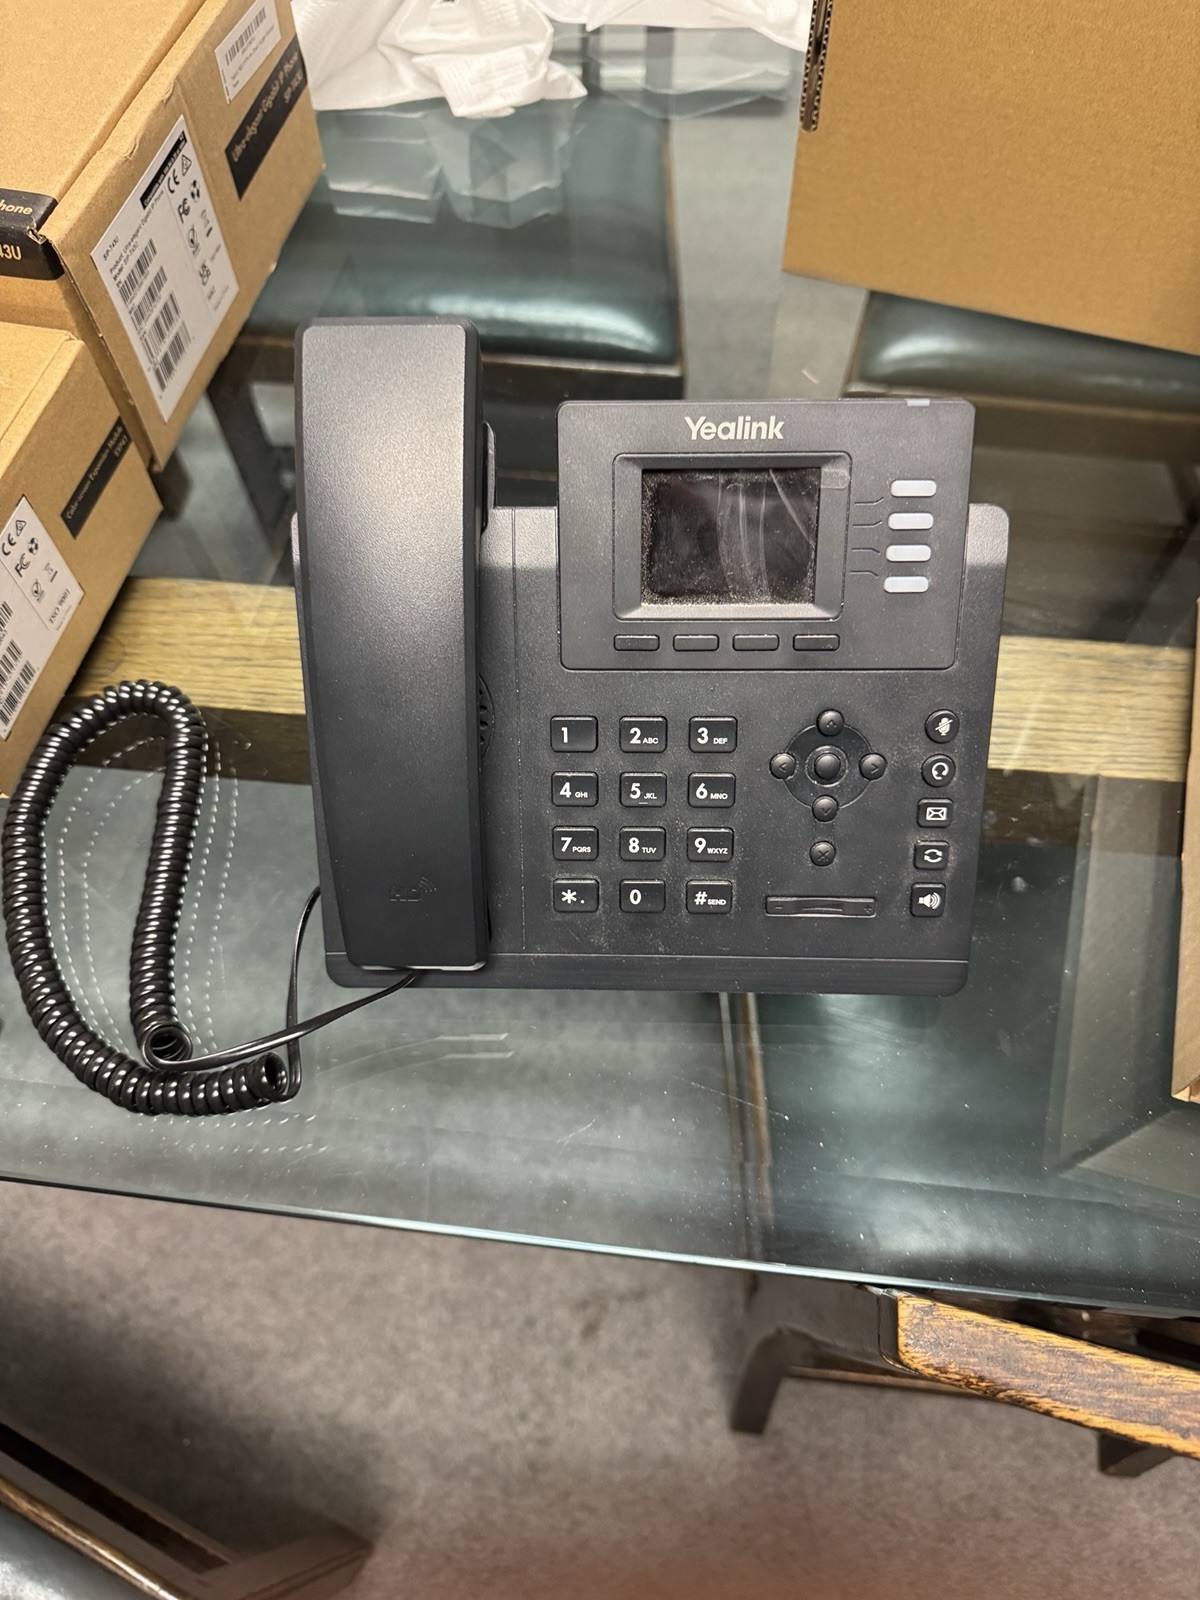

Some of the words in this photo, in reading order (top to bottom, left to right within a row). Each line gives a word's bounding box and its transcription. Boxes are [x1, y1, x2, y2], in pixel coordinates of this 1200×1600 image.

[684, 415, 785, 441] Yealink
[561, 727, 569, 743] 1
[629, 727, 641, 744] 2
[697, 727, 709, 744] 3
[559, 782, 572, 798] 4
[629, 783, 641, 799] 5
[695, 783, 708, 799] 6
[710, 792, 728, 800] MNO
[560, 837, 572, 852] 7
[628, 837, 640, 853] 8
[694, 837, 707, 853] 9
[629, 889, 642, 905] 0
